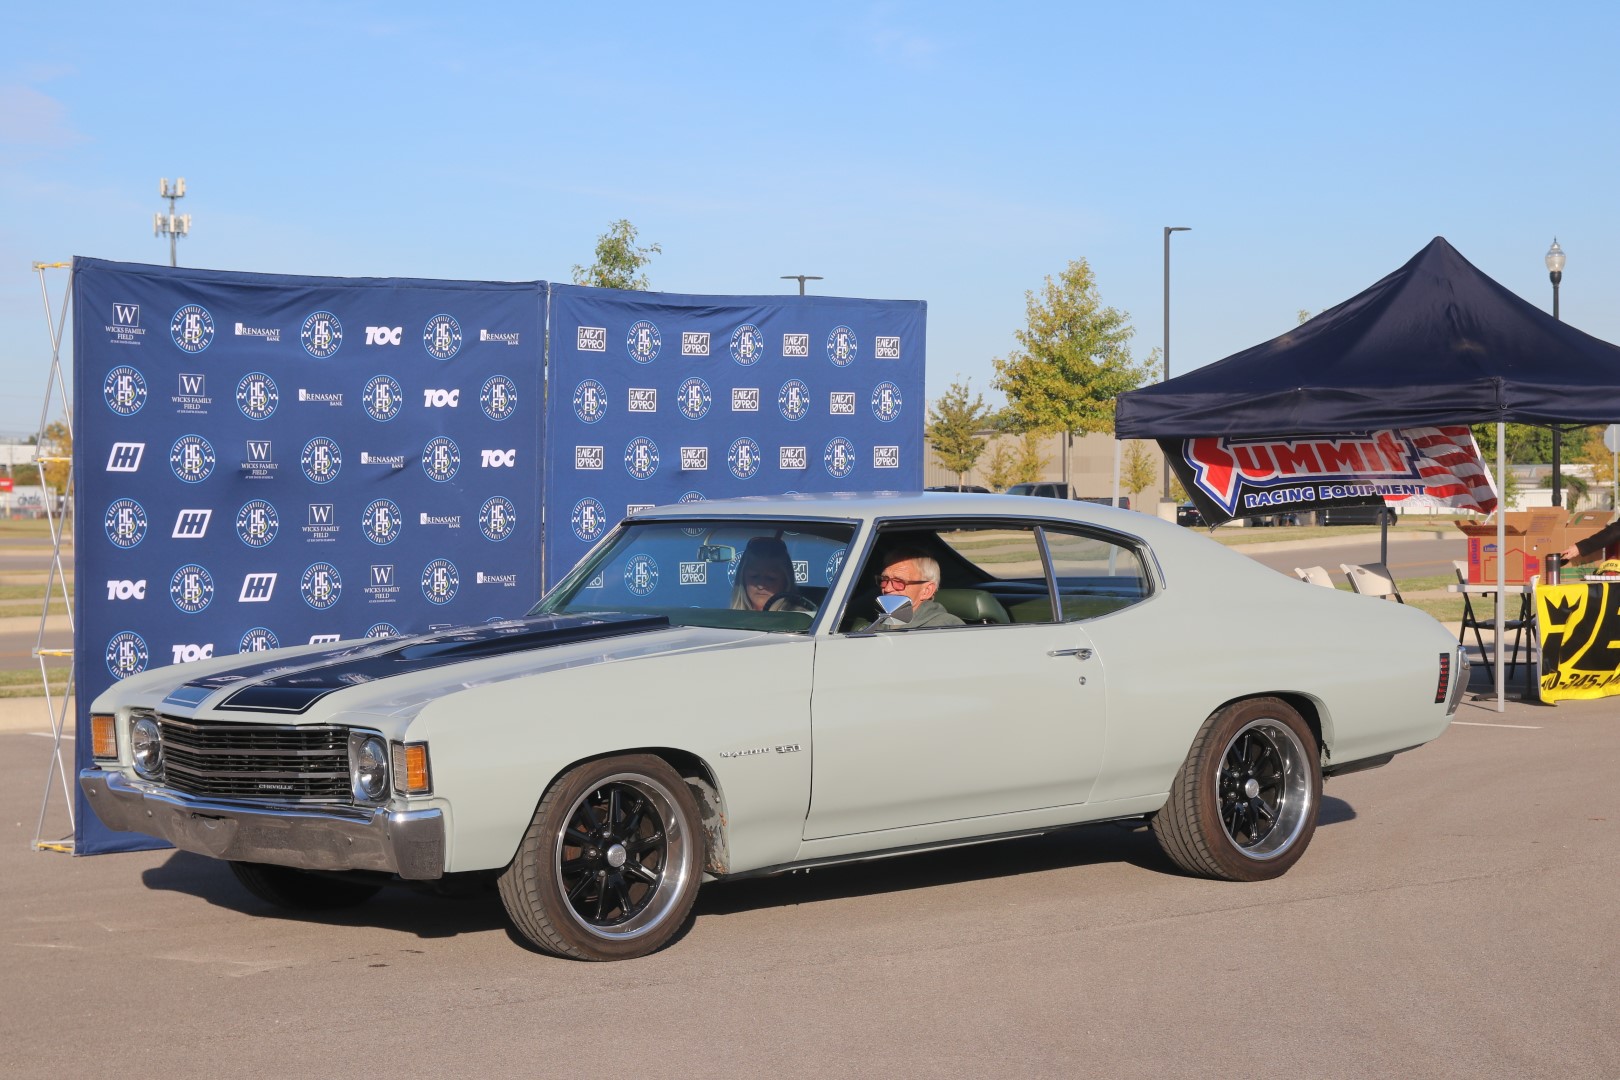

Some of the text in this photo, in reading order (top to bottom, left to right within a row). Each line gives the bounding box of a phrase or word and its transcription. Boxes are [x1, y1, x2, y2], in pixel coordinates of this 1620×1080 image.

[116, 306, 137, 324] W
[186, 314, 200, 328] HC
[106, 326, 124, 334] WICKS
[315, 321, 329, 334] HC
[436, 324, 449, 336] HC
[185, 330, 199, 343] FC
[365, 327, 402, 345] TOC
[638, 329, 650, 342] HC
[741, 332, 752, 344] HC
[837, 334, 847, 346] HC
[315, 336, 328, 349] FC
[436, 338, 449, 351] FC
[638, 343, 649, 355] FC
[741, 346, 752, 358] FC
[837, 347, 847, 359] FC
[119, 376, 133, 390] HC
[182, 377, 202, 394] W
[250, 382, 264, 396] HC
[376, 385, 389, 398] HC
[493, 385, 505, 397] HC
[585, 388, 596, 401] HC
[689, 386, 700, 398] HC
[789, 388, 799, 399] HC
[882, 390, 892, 401] HC
[118, 392, 132, 406] FC
[250, 397, 264, 410] FC
[424, 389, 459, 407] TOC
[376, 400, 389, 412] FC
[492, 399, 504, 412] FC
[585, 403, 596, 415] FC
[689, 400, 700, 411] FC
[788, 401, 799, 413] FC
[882, 403, 892, 414] FC
[185, 444, 200, 458] HC
[250, 443, 269, 459] W
[315, 447, 328, 460] HC
[435, 446, 448, 459] HC
[636, 445, 648, 458] HC
[739, 446, 749, 458] HC
[835, 445, 845, 457] HC
[481, 449, 516, 467] TOC
[834, 458, 844, 470] FC
[185, 460, 200, 473] FC
[314, 462, 328, 475] FC
[435, 460, 447, 473] FC
[636, 459, 647, 471] FC
[738, 460, 749, 471] FC
[1244, 484, 1426, 508] RACING EQUIPMENT
[119, 509, 133, 523] HC
[251, 509, 265, 523] HC
[312, 506, 330, 522] W
[376, 508, 388, 521] HC
[491, 506, 503, 518] HC
[583, 506, 595, 519] HC
[119, 525, 133, 538] FC
[250, 525, 264, 538] FC
[375, 523, 388, 536] FC
[491, 520, 503, 532] FC
[583, 521, 594, 533] FC
[373, 567, 391, 583] W
[434, 568, 447, 581] HC
[636, 563, 647, 575] HC
[185, 574, 199, 588] HC
[315, 572, 328, 586] HC
[636, 576, 647, 588] FC
[107, 580, 146, 600] TOC
[314, 587, 328, 600] FC
[434, 583, 446, 596] FC
[184, 590, 199, 604] FC
[120, 642, 134, 656] HC
[253, 637, 266, 651] HC
[172, 644, 213, 664] TOC
[120, 658, 134, 671] FC
[775, 744, 802, 754] 350
